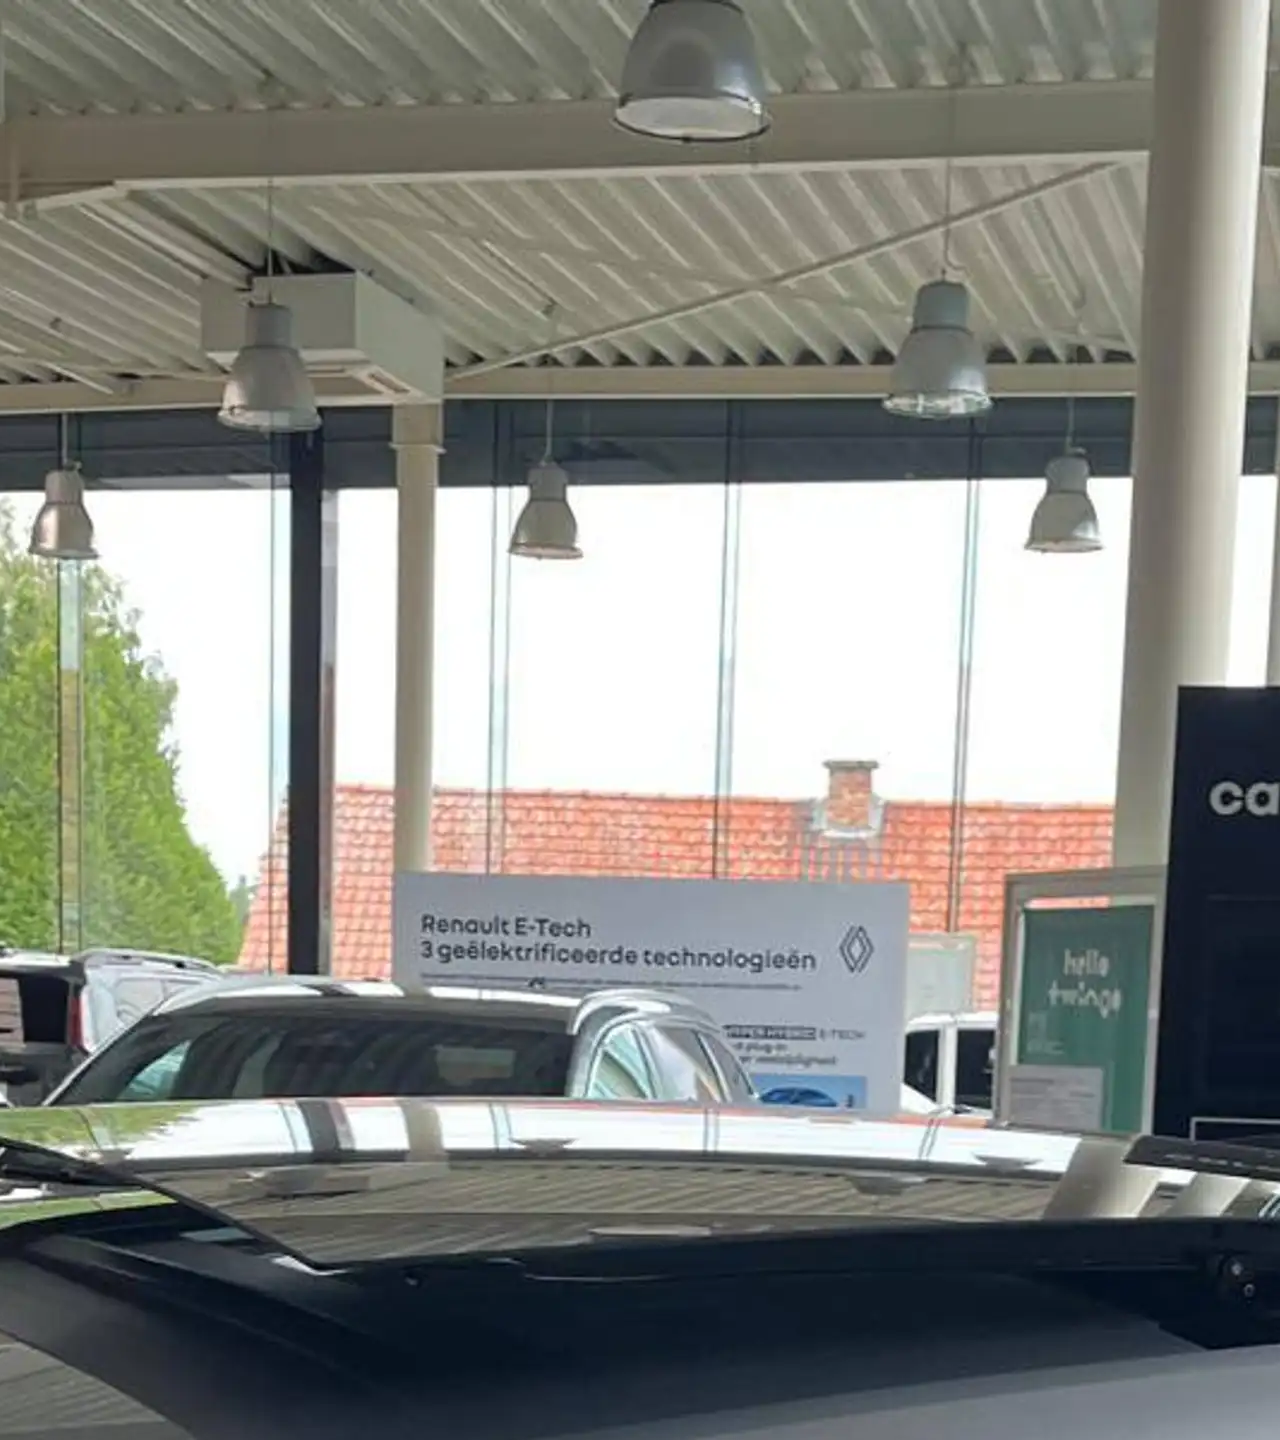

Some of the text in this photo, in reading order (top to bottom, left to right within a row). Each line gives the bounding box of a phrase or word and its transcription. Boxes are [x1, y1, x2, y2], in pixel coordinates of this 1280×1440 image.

[420, 914, 592, 938] Renault E-Tech
[420, 940, 817, 973] 3 geëlektrificeerde technologieën
[1063, 948, 1111, 977] hello
